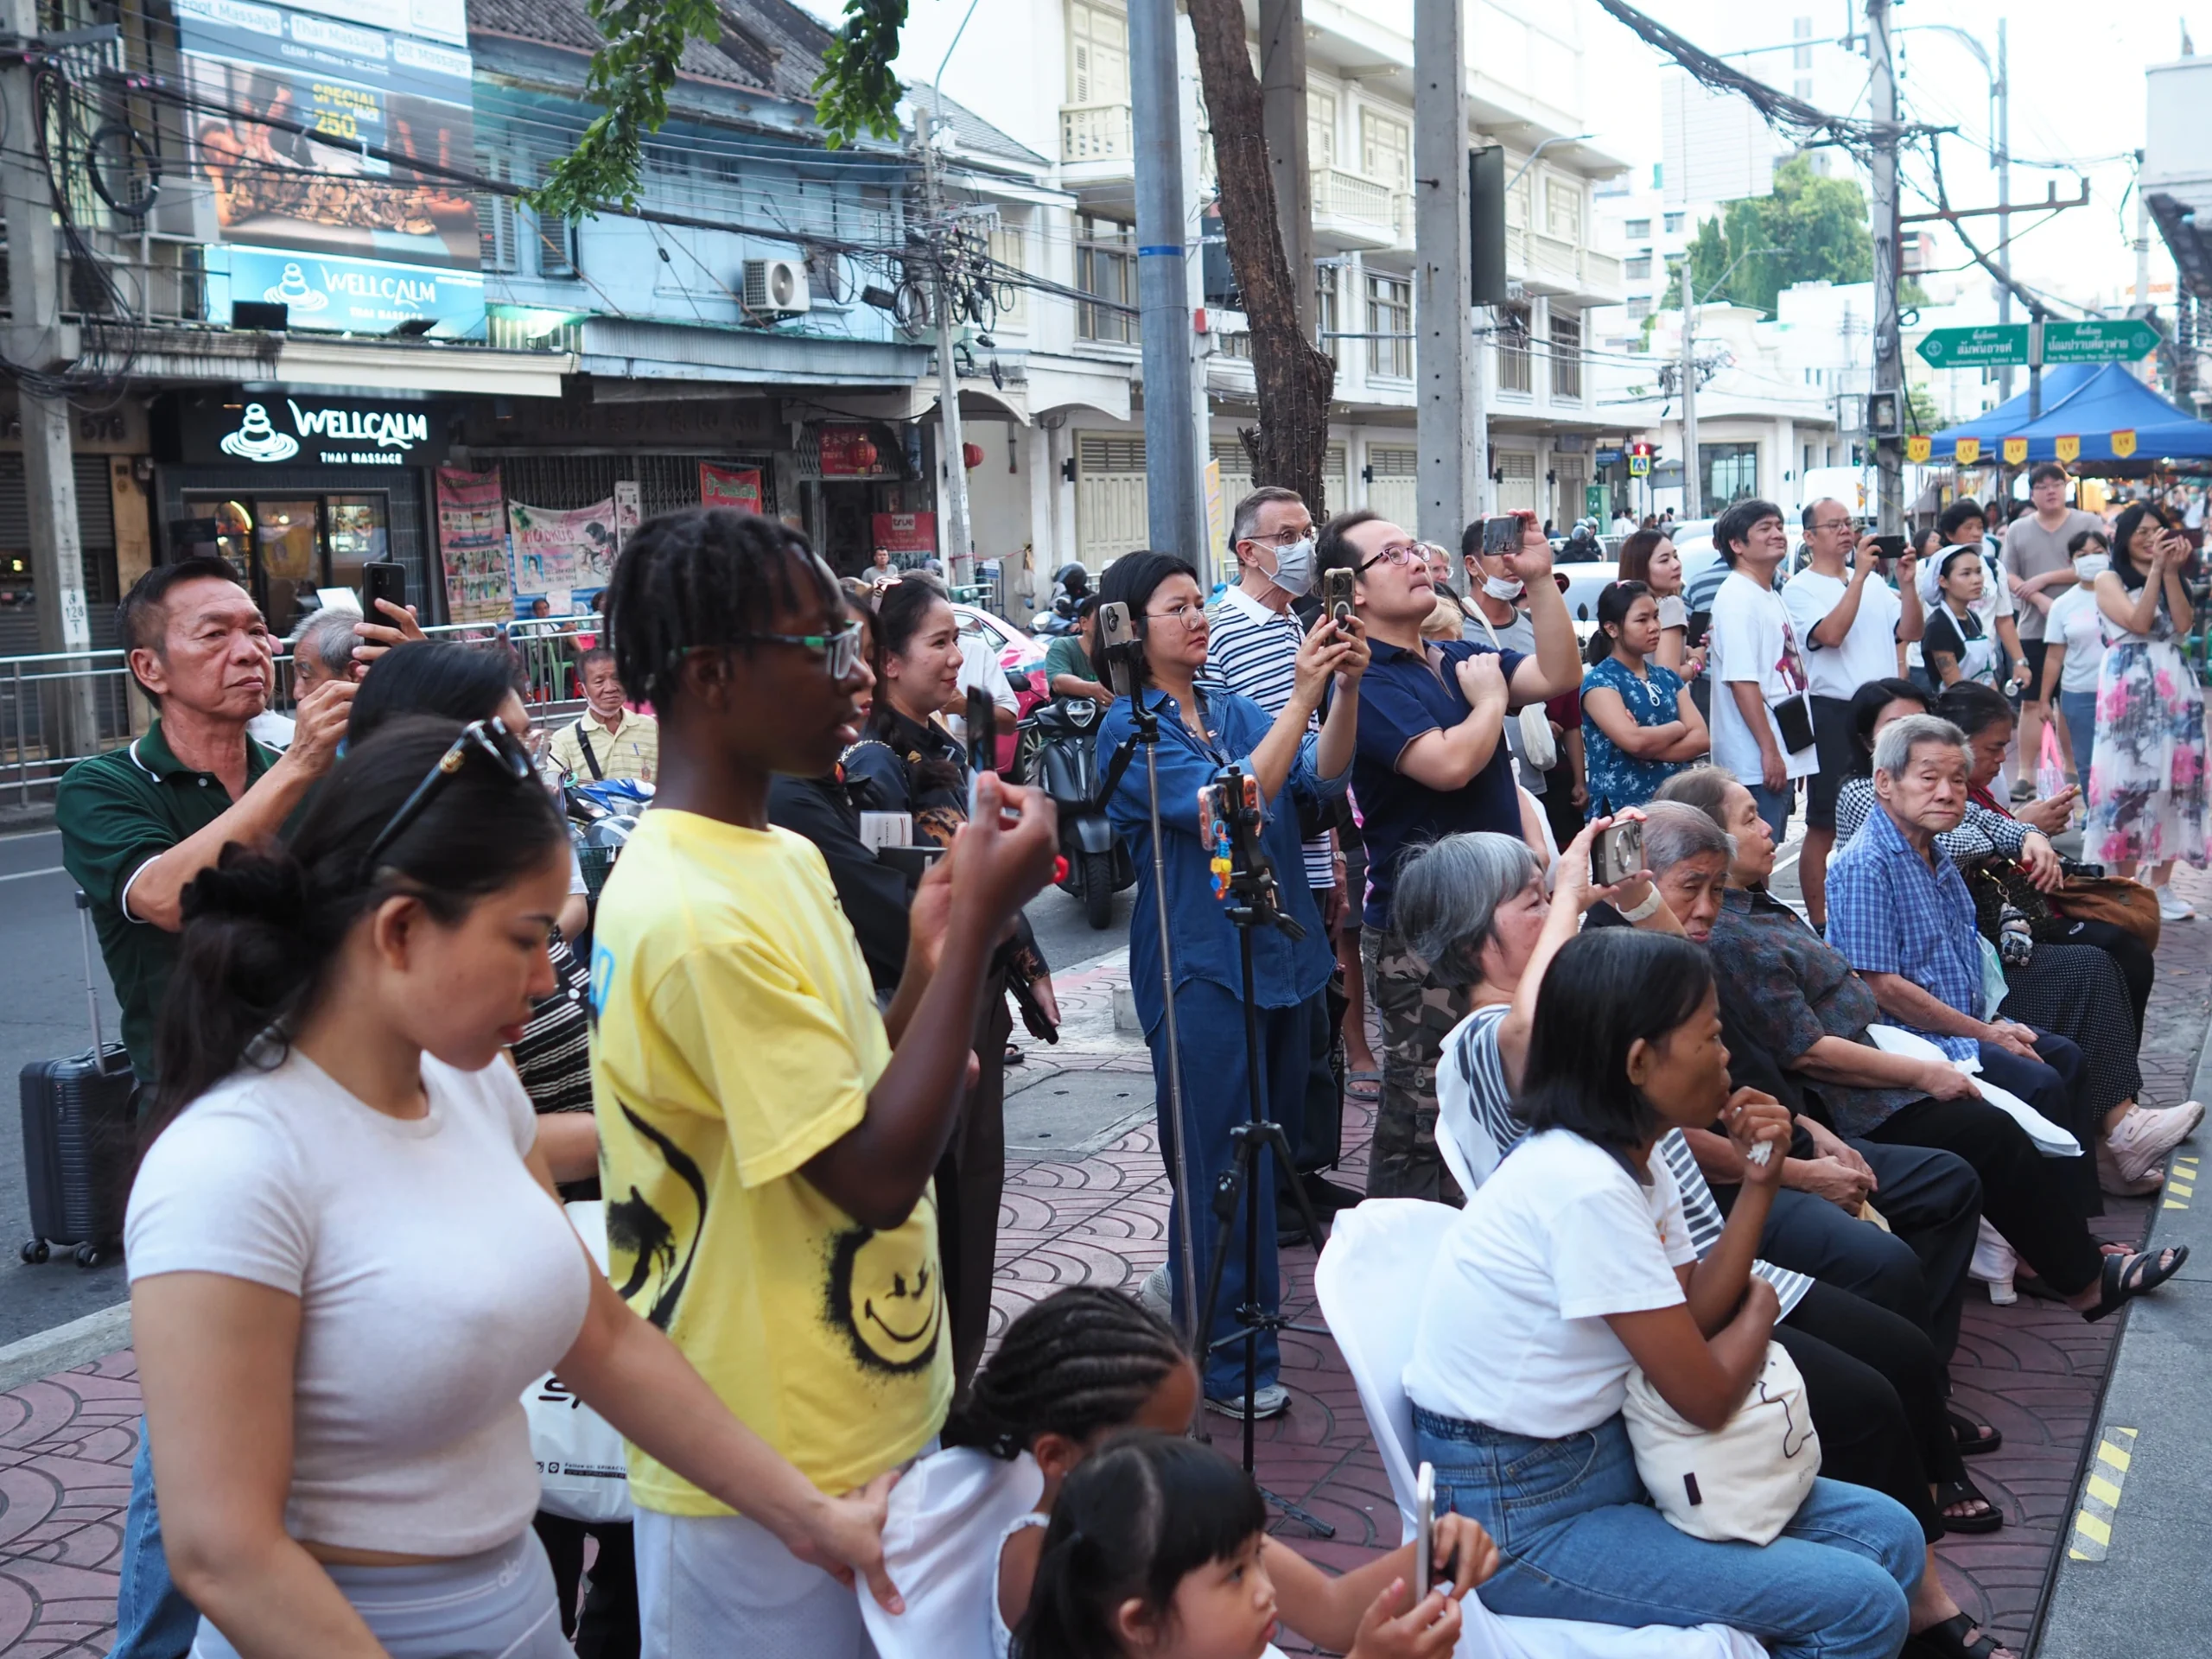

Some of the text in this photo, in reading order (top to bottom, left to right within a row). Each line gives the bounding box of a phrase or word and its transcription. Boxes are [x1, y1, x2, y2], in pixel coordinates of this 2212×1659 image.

[219, 3, 278, 29] Massage
[294, 18, 384, 54] Thai Massage
[313, 83, 379, 112] SPECIAL
[313, 109, 357, 140] 250
[319, 263, 435, 308] WELLCALM
[287, 398, 428, 449] WELLCALM
[320, 451, 403, 465] THAI MASSAGE
[893, 518, 914, 526] true
[65, 605, 84, 619] 128
[73, 621, 79, 635] 1
